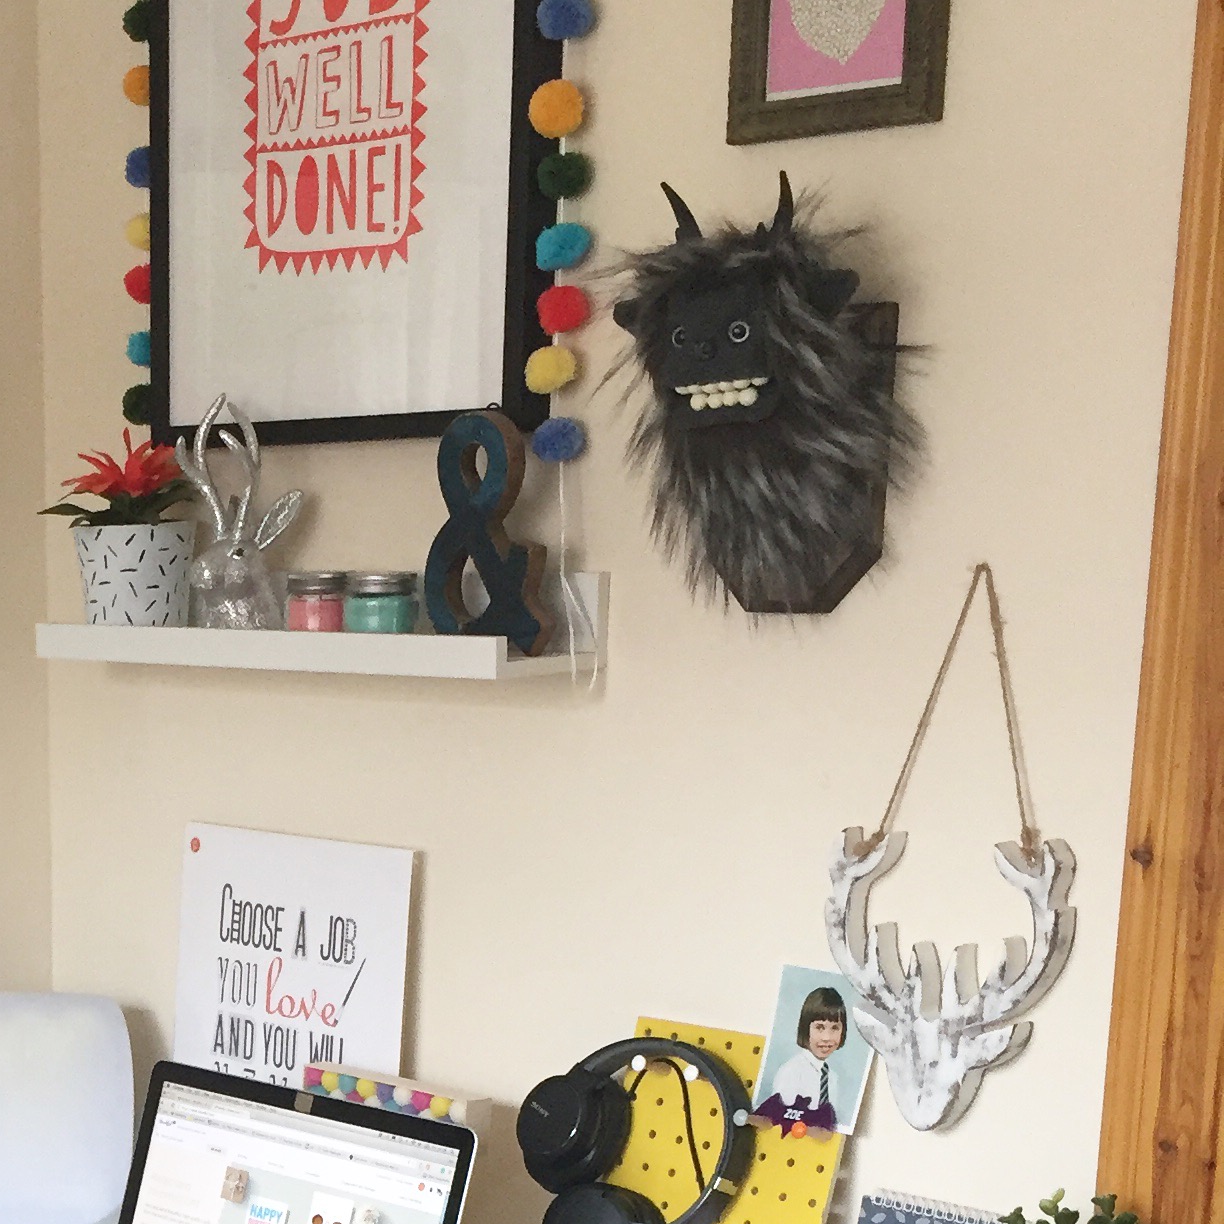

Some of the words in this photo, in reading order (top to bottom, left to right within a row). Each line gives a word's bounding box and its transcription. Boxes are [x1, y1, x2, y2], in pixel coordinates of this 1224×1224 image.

[265, 34, 404, 135] WELL
[266, 143, 402, 238] DONE!
[219, 882, 285, 953] CHOOSE
[294, 909, 308, 959] A
[319, 914, 358, 966] JOB
[217, 956, 258, 1007] YOU
[265, 956, 337, 1029] love
[213, 1012, 255, 1061] AND
[262, 1022, 299, 1072] YOU
[783, 1108, 805, 1122] ZOE
[249, 1203, 284, 1224] HAPPY
